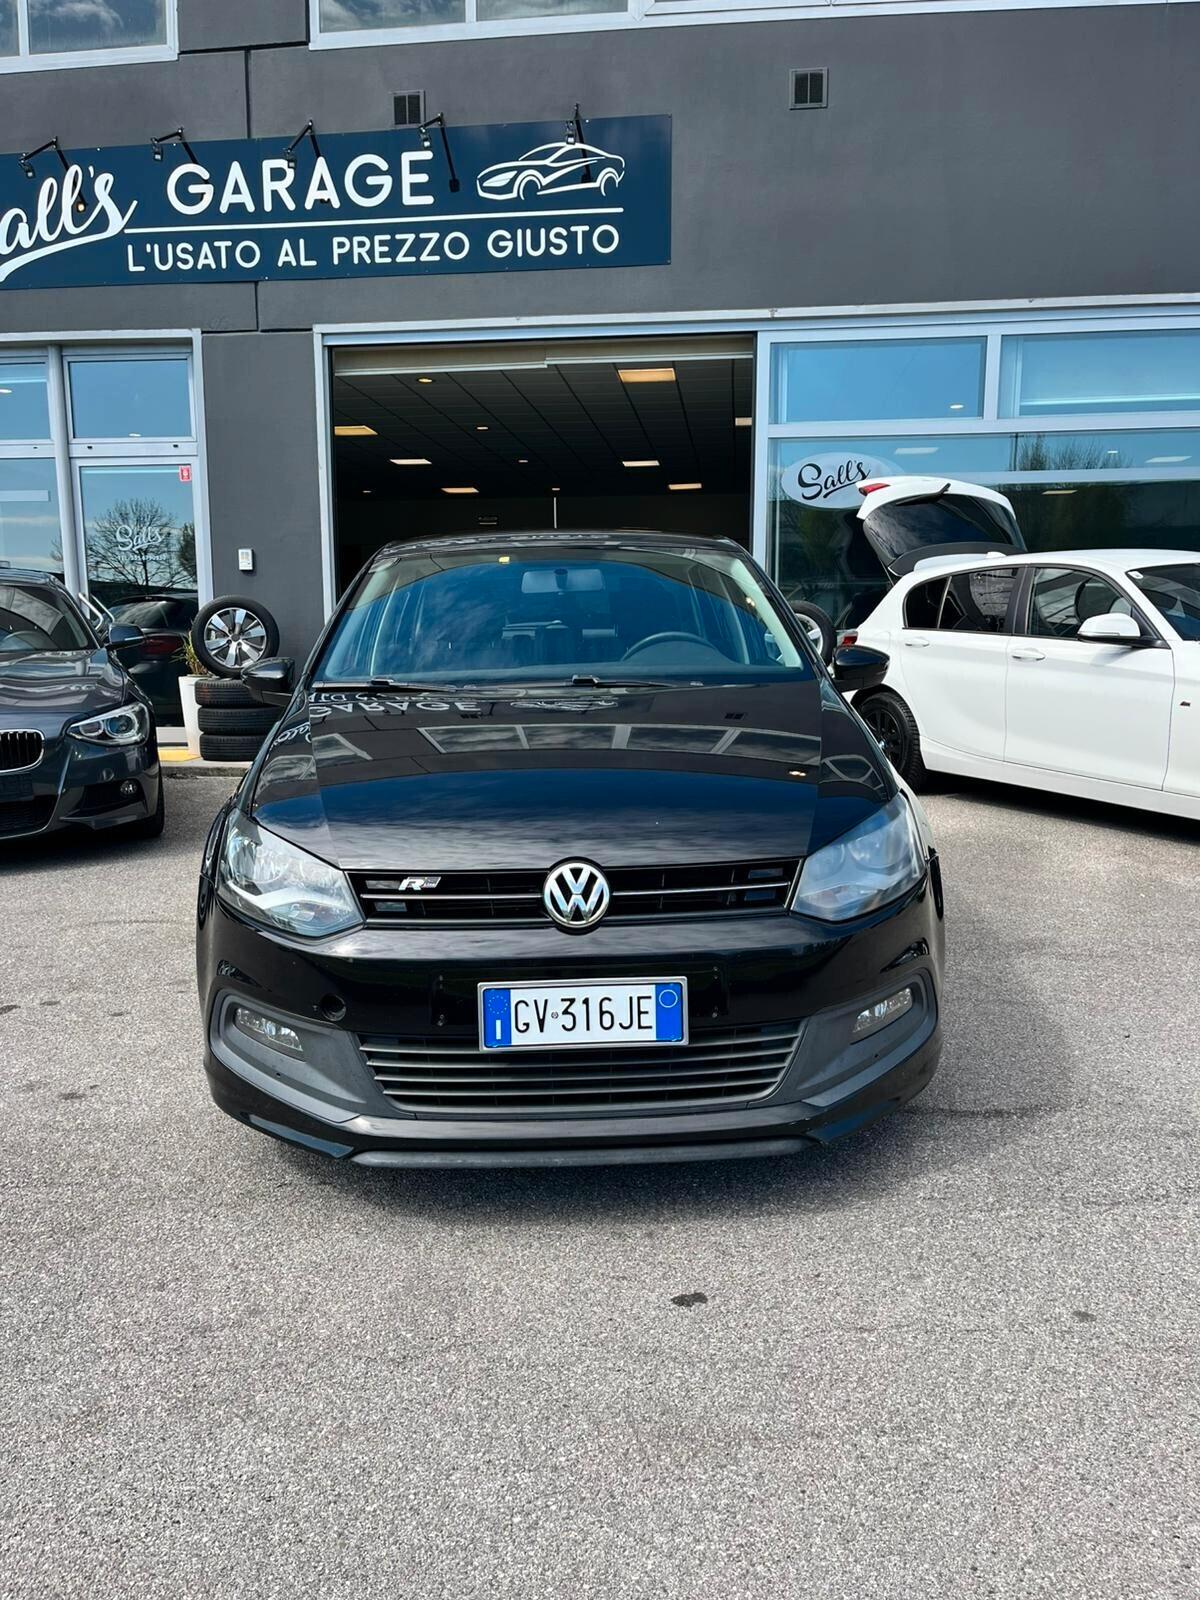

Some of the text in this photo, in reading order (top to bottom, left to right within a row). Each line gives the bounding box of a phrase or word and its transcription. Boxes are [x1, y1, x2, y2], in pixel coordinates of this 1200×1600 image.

[0, 150, 435, 268] all's GARAGE
[127, 224, 620, 272] L'USATO AL PREZZO GIUSTO
[797, 460, 871, 501] Sall's
